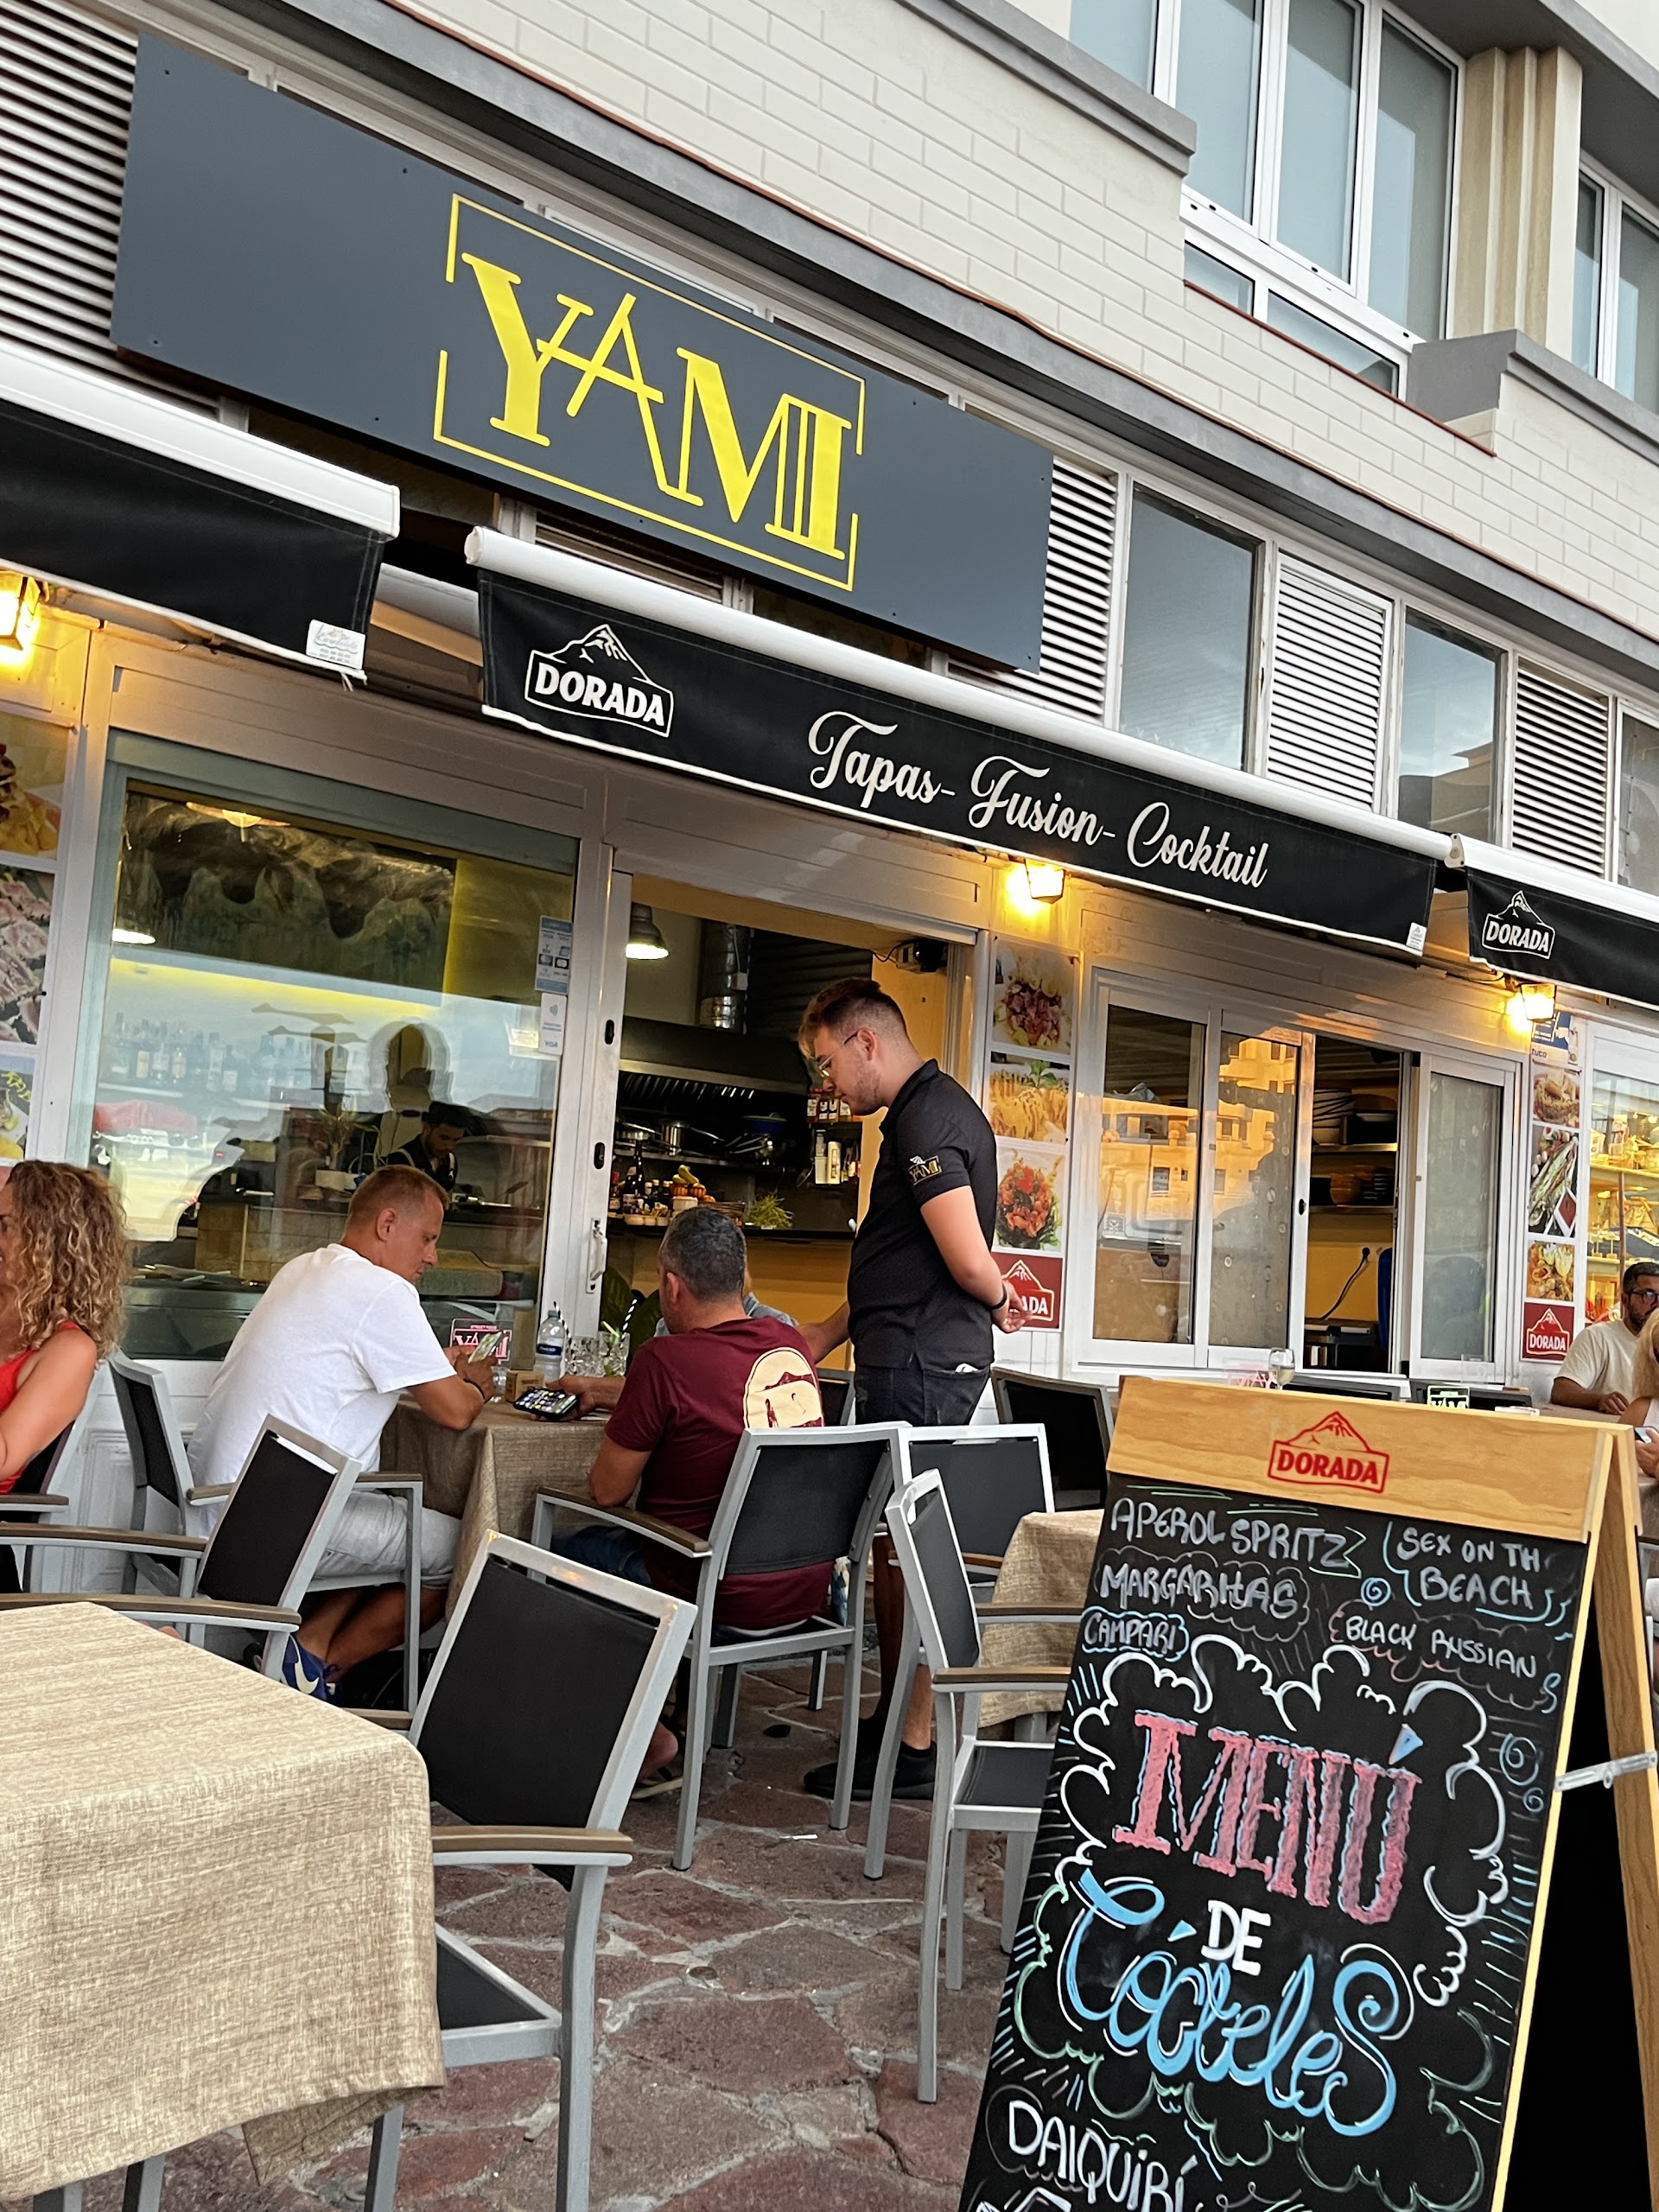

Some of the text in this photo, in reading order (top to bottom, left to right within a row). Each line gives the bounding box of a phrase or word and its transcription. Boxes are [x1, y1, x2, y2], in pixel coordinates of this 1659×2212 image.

[461, 252, 852, 561] YAMI
[534, 662, 665, 728] DORADA
[1127, 802, 1268, 888] Cocktail
[1485, 920, 1550, 953] DORADA
[1529, 1333, 1567, 1351] DORADA
[1276, 1449, 1378, 1485] DORADA
[1111, 1497, 1350, 1569] APEROL SPRITZ
[1396, 1527, 1451, 1560] SEX
[1461, 1540, 1495, 1563] ON
[1420, 1566, 1534, 1610] BEACH
[1084, 1612, 1177, 1655] CAMPARI
[1345, 1616, 1537, 1679] BLACK RUSSIAN
[1201, 1900, 1271, 1976] DE
